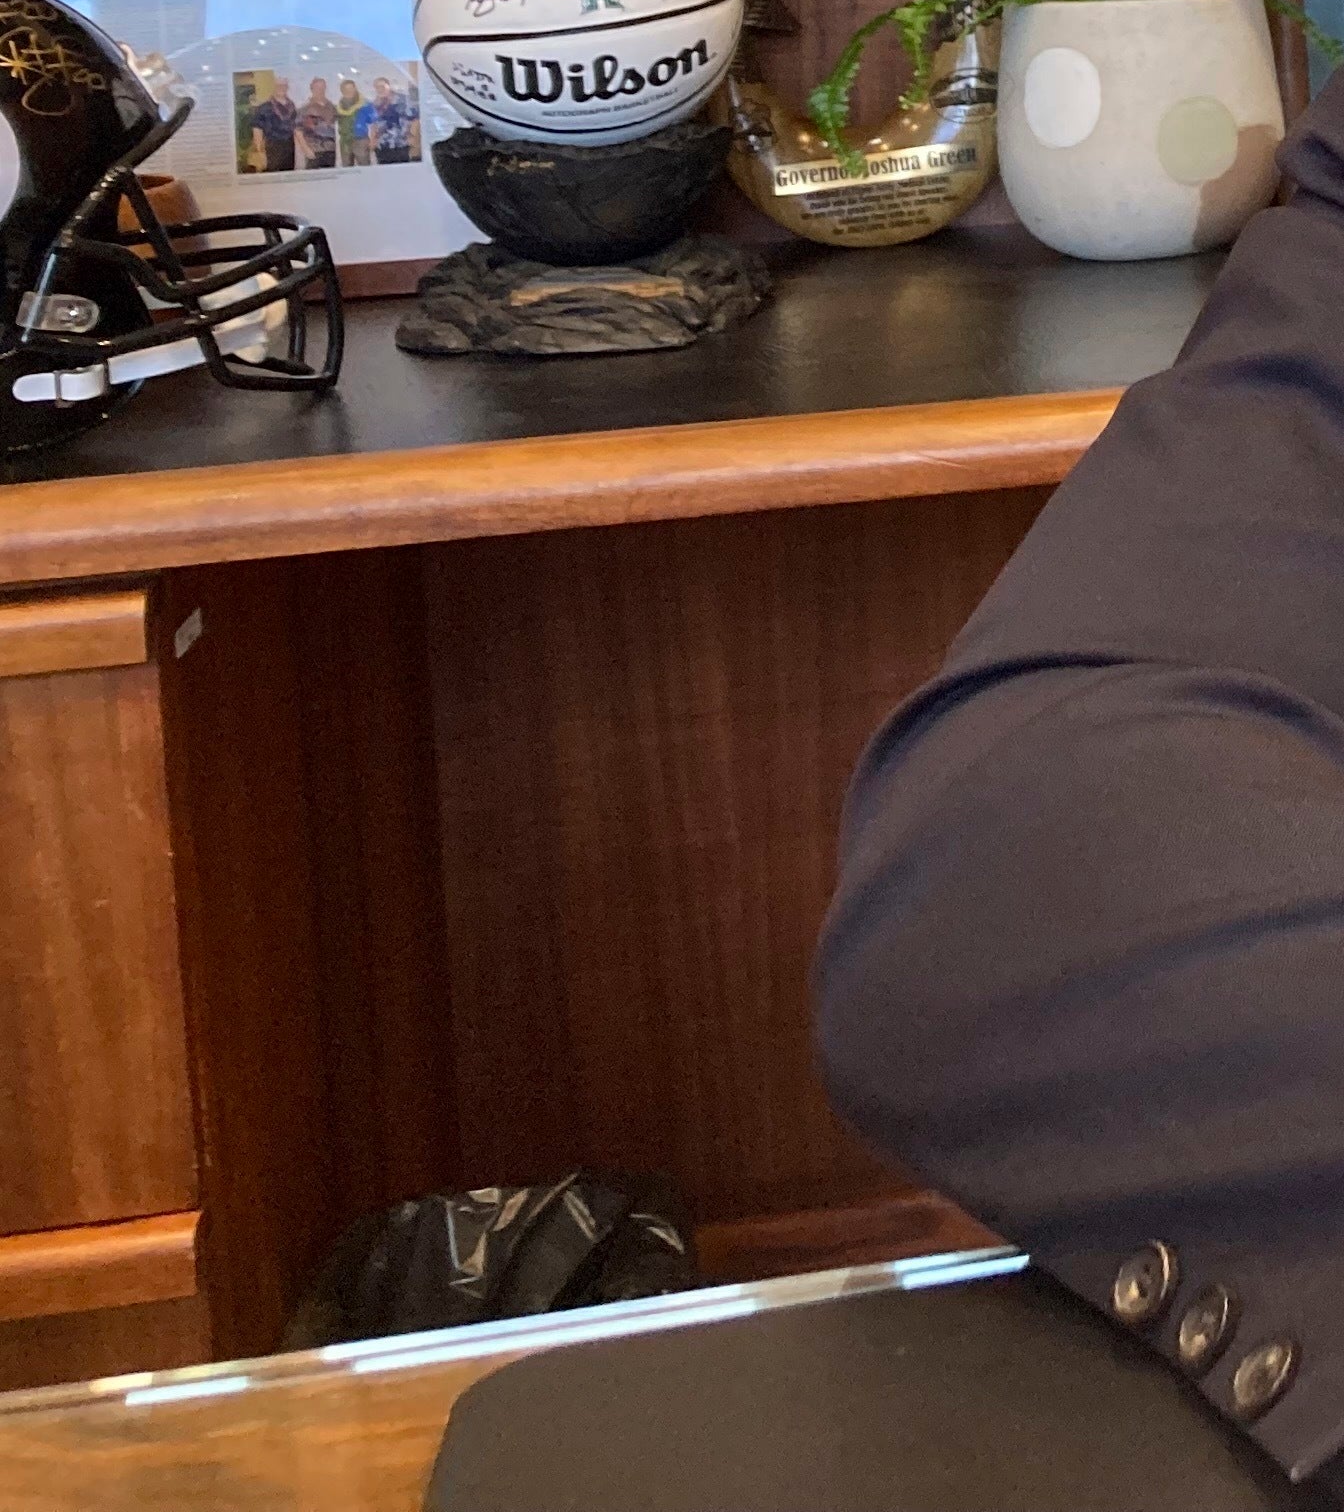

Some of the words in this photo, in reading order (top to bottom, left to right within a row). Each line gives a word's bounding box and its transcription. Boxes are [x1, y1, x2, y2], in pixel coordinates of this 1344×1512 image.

[494, 38, 711, 104] Wilson
[776, 166, 848, 186] Governo
[926, 146, 977, 169] Green
